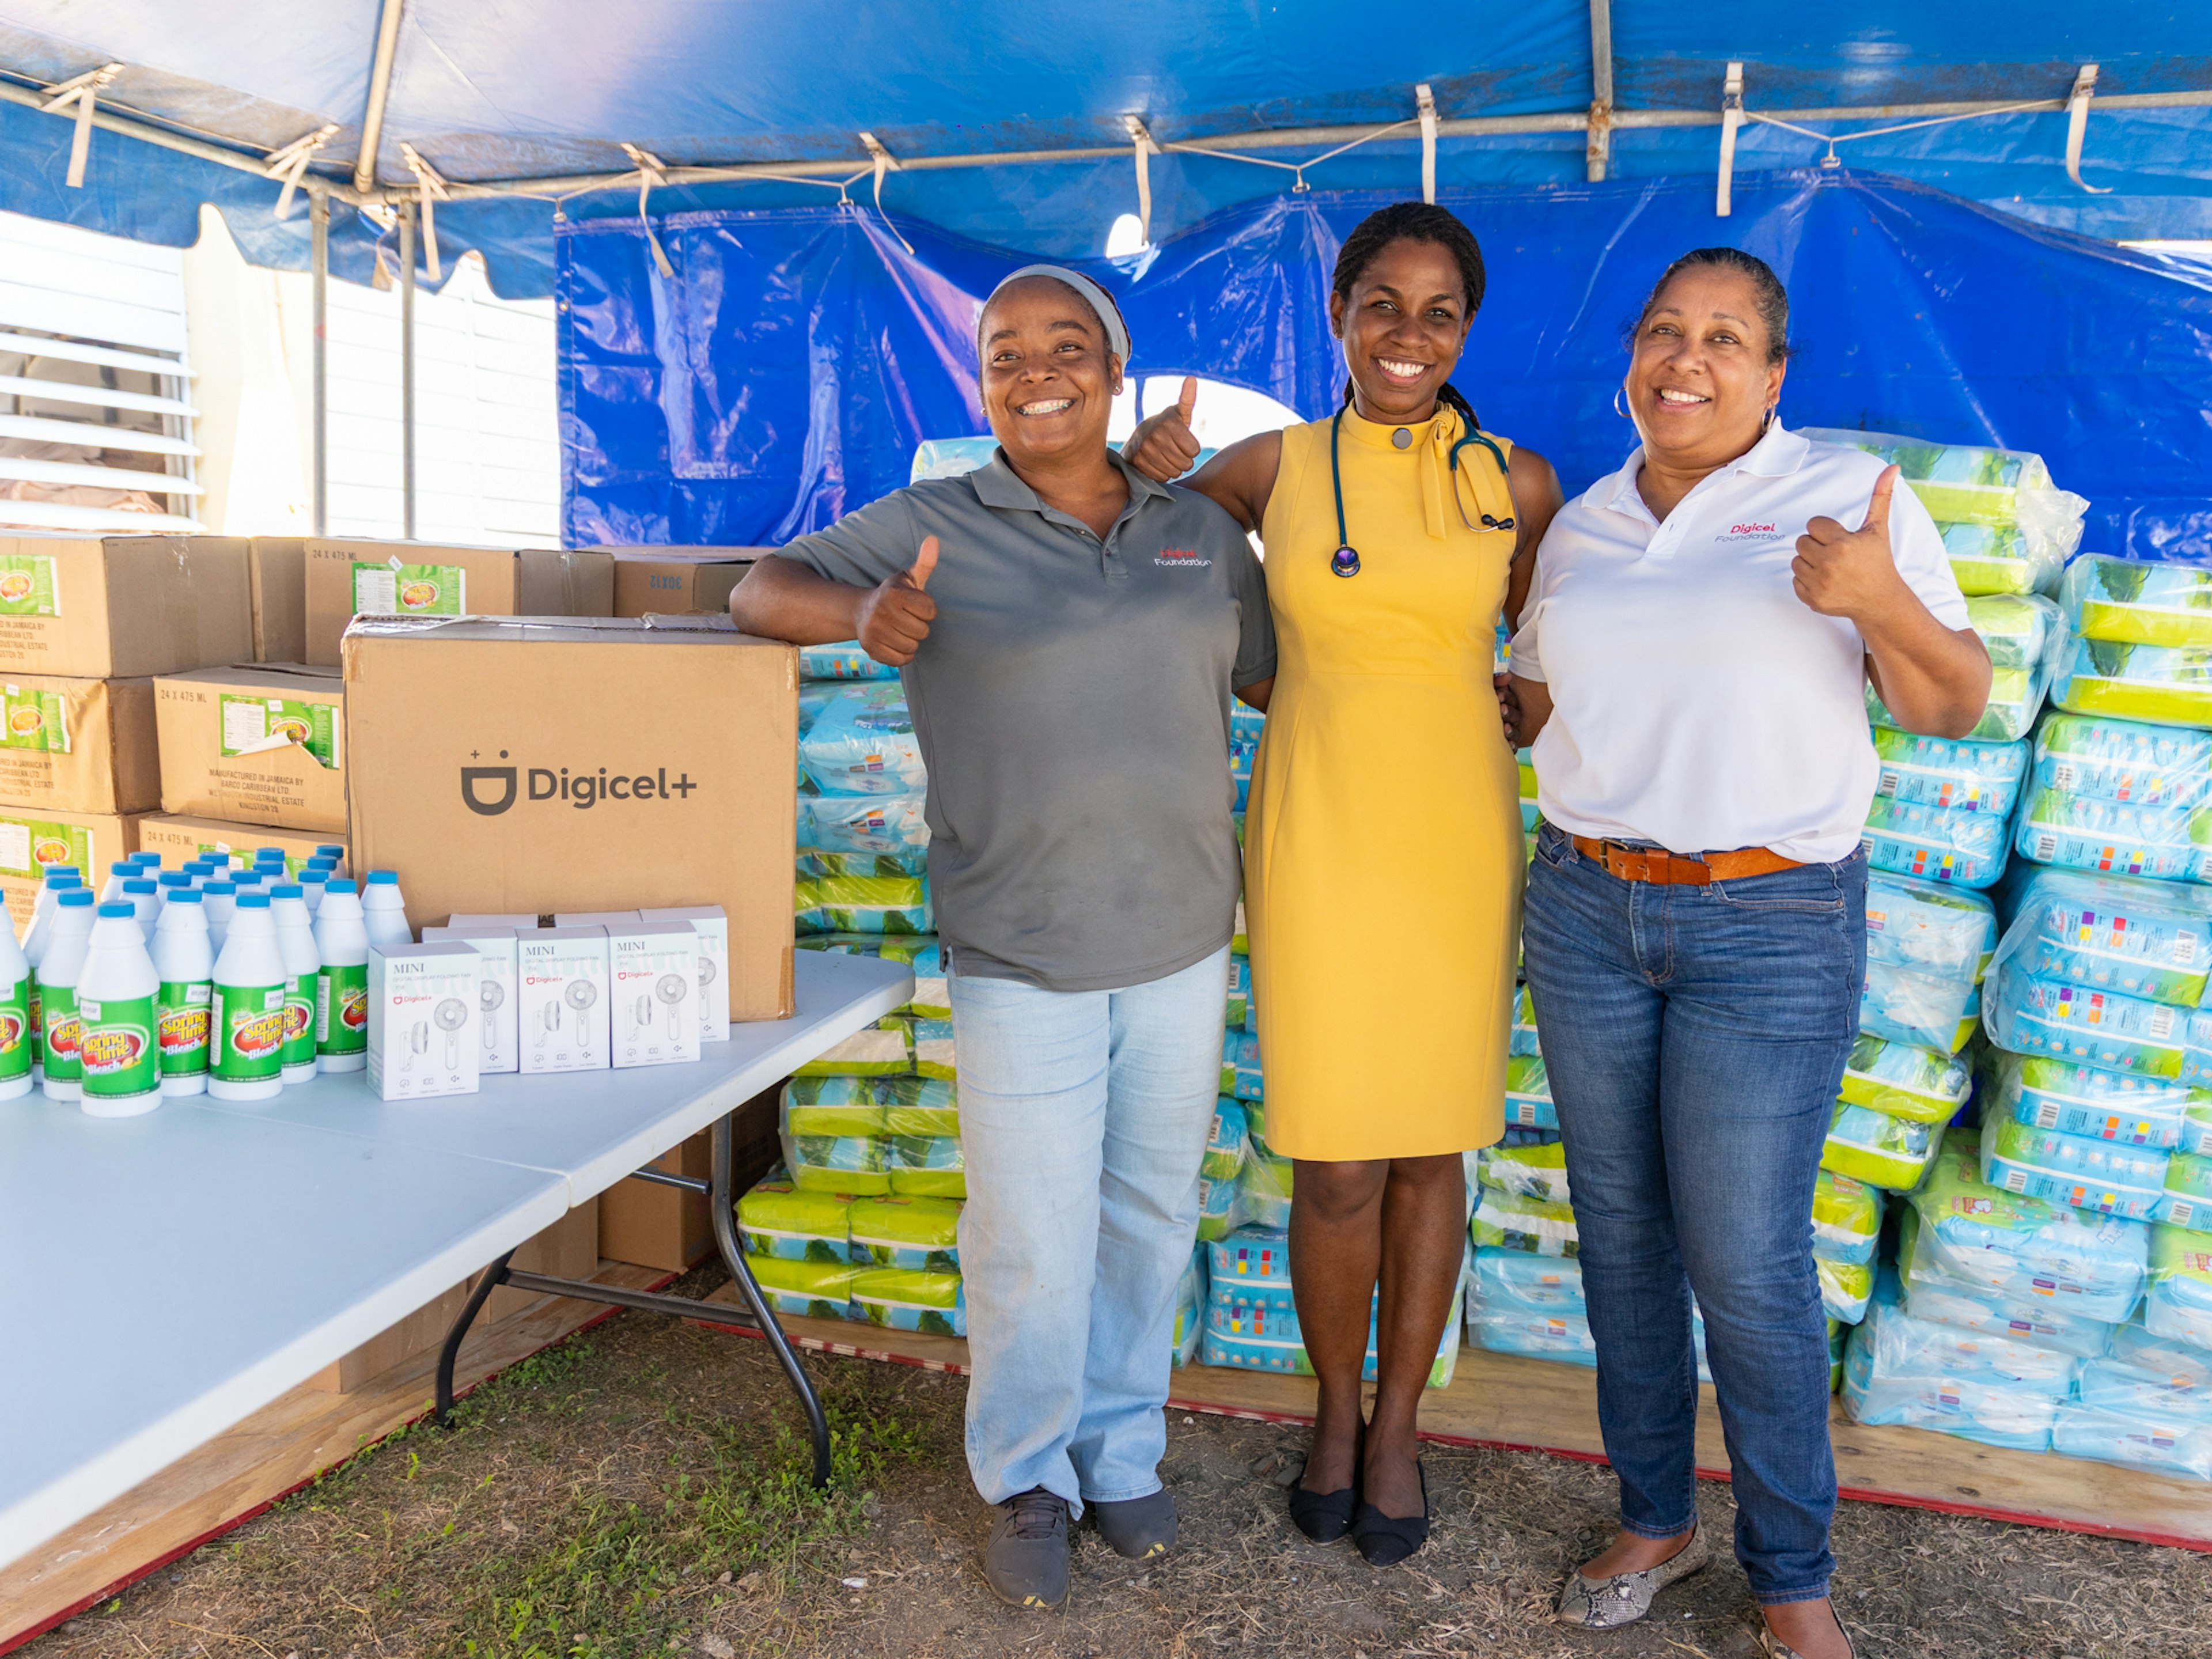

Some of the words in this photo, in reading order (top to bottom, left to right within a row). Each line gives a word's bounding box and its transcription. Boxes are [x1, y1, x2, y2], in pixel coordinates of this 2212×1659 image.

[1730, 522, 1775, 534] Digicel
[1714, 533, 1786, 542] Foundation
[313, 550, 321, 558] 24
[324, 551, 329, 559] X
[332, 551, 345, 560] 475
[348, 552, 357, 561] ML
[1154, 558, 1212, 567] Foundation
[161, 690, 170, 699] 24
[172, 691, 177, 700] X
[180, 692, 194, 702] 475
[197, 693, 207, 703] ML
[209, 769, 257, 781] MANUFACTURED
[267, 775, 294, 785] JAMAICA
[34, 781, 55, 790] ESTATE
[242, 782, 276, 793] CARIBBEAN
[528, 768, 697, 809] Digicel+
[238, 802, 270, 812] KINGSTON
[282, 797, 305, 807] ESTATE
[148, 831, 157, 841] 24
[159, 833, 164, 842] X
[167, 834, 181, 844] 475
[184, 836, 194, 846] ML
[526, 946, 554, 956] MINI
[617, 941, 645, 952] MINI
[393, 963, 424, 974] MINI
[403, 995, 432, 1003] Digicel+
[162, 1011, 206, 1035] Spring
[244, 1014, 283, 1040] Spring
[177, 1023, 209, 1040] Time
[84, 1032, 126, 1054] Spring
[166, 1039, 200, 1056] Bleach
[94, 1044, 132, 1061] Time
[248, 1041, 279, 1060] Bleach
[87, 1060, 122, 1075] Bleach
